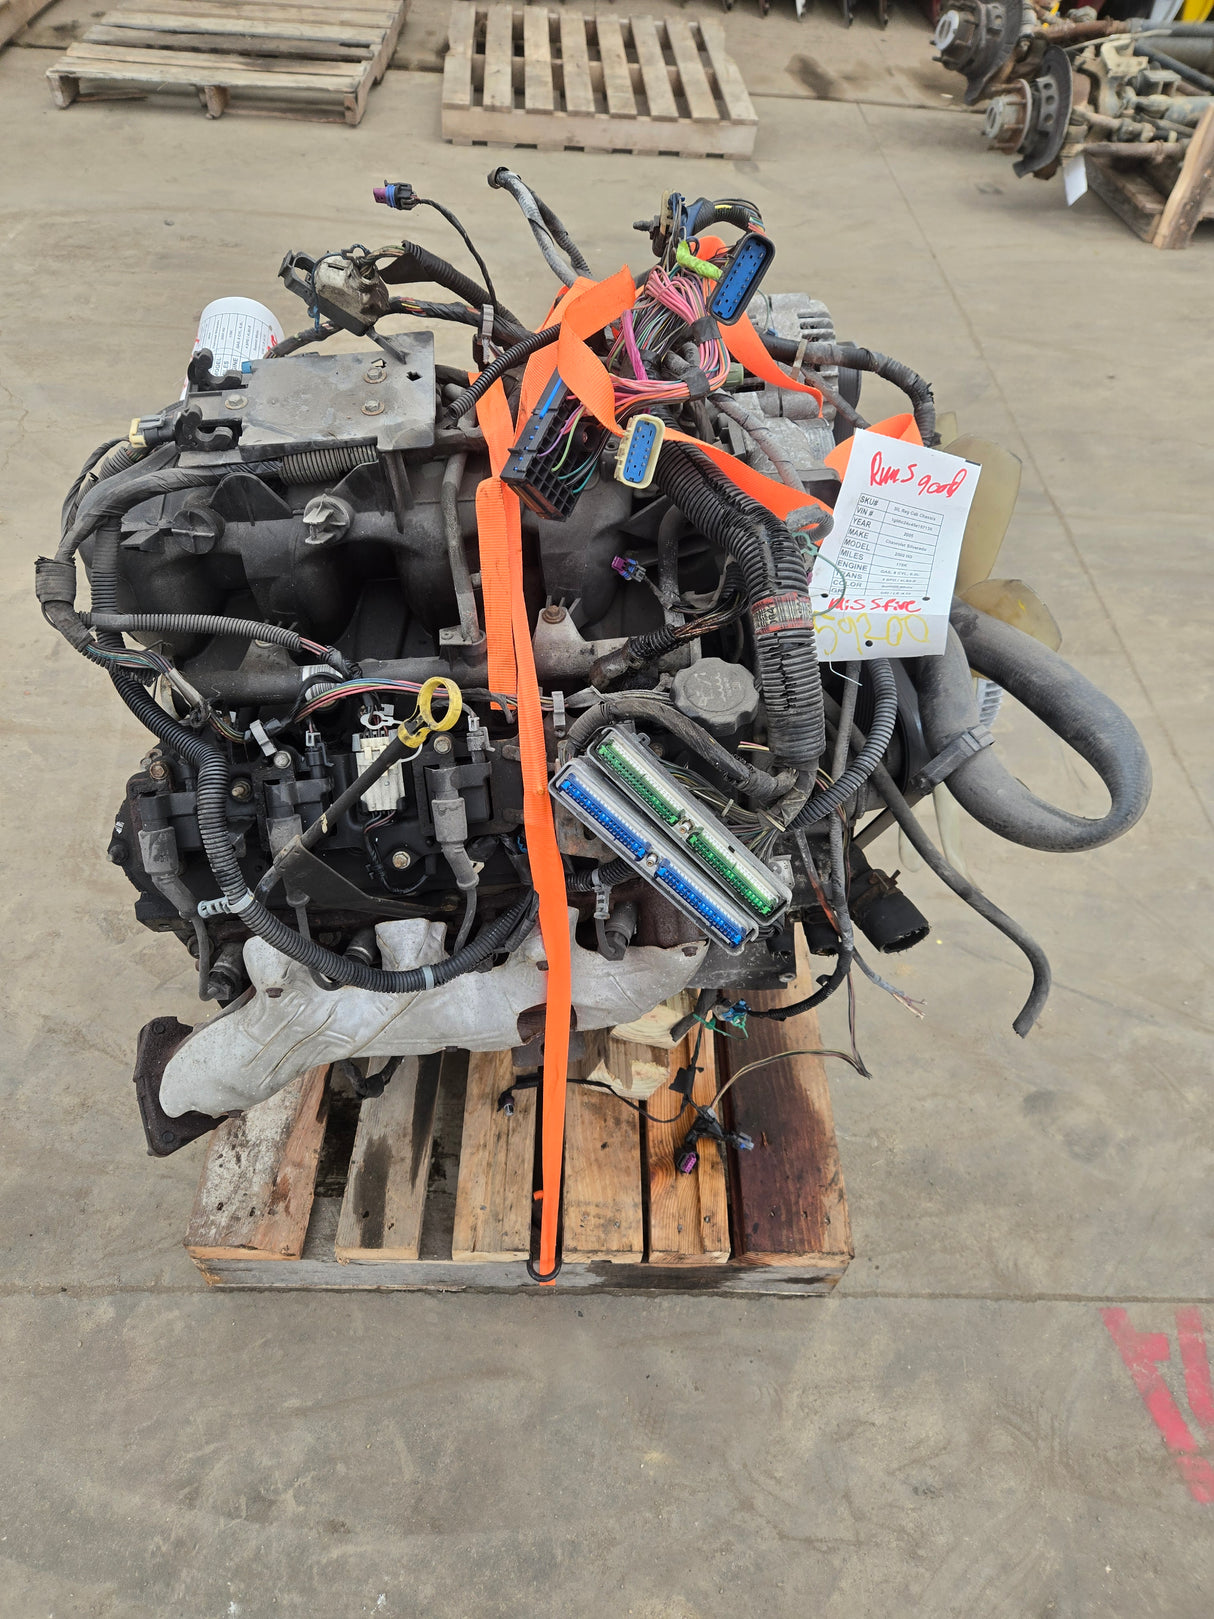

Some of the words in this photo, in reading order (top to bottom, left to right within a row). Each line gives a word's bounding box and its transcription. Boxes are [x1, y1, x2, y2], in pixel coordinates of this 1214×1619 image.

[918, 468, 967, 498] good
[859, 495, 879, 506] SKU#
[856, 506, 867, 515] VIN
[852, 517, 872, 528] YEAR
[848, 527, 869, 539] MAKE
[844, 538, 870, 551] MODEL
[840, 549, 864, 560] MILES
[837, 559, 868, 571] ENGINE
[835, 570, 863, 579] TRANS
[833, 579, 862, 588] COLOR
